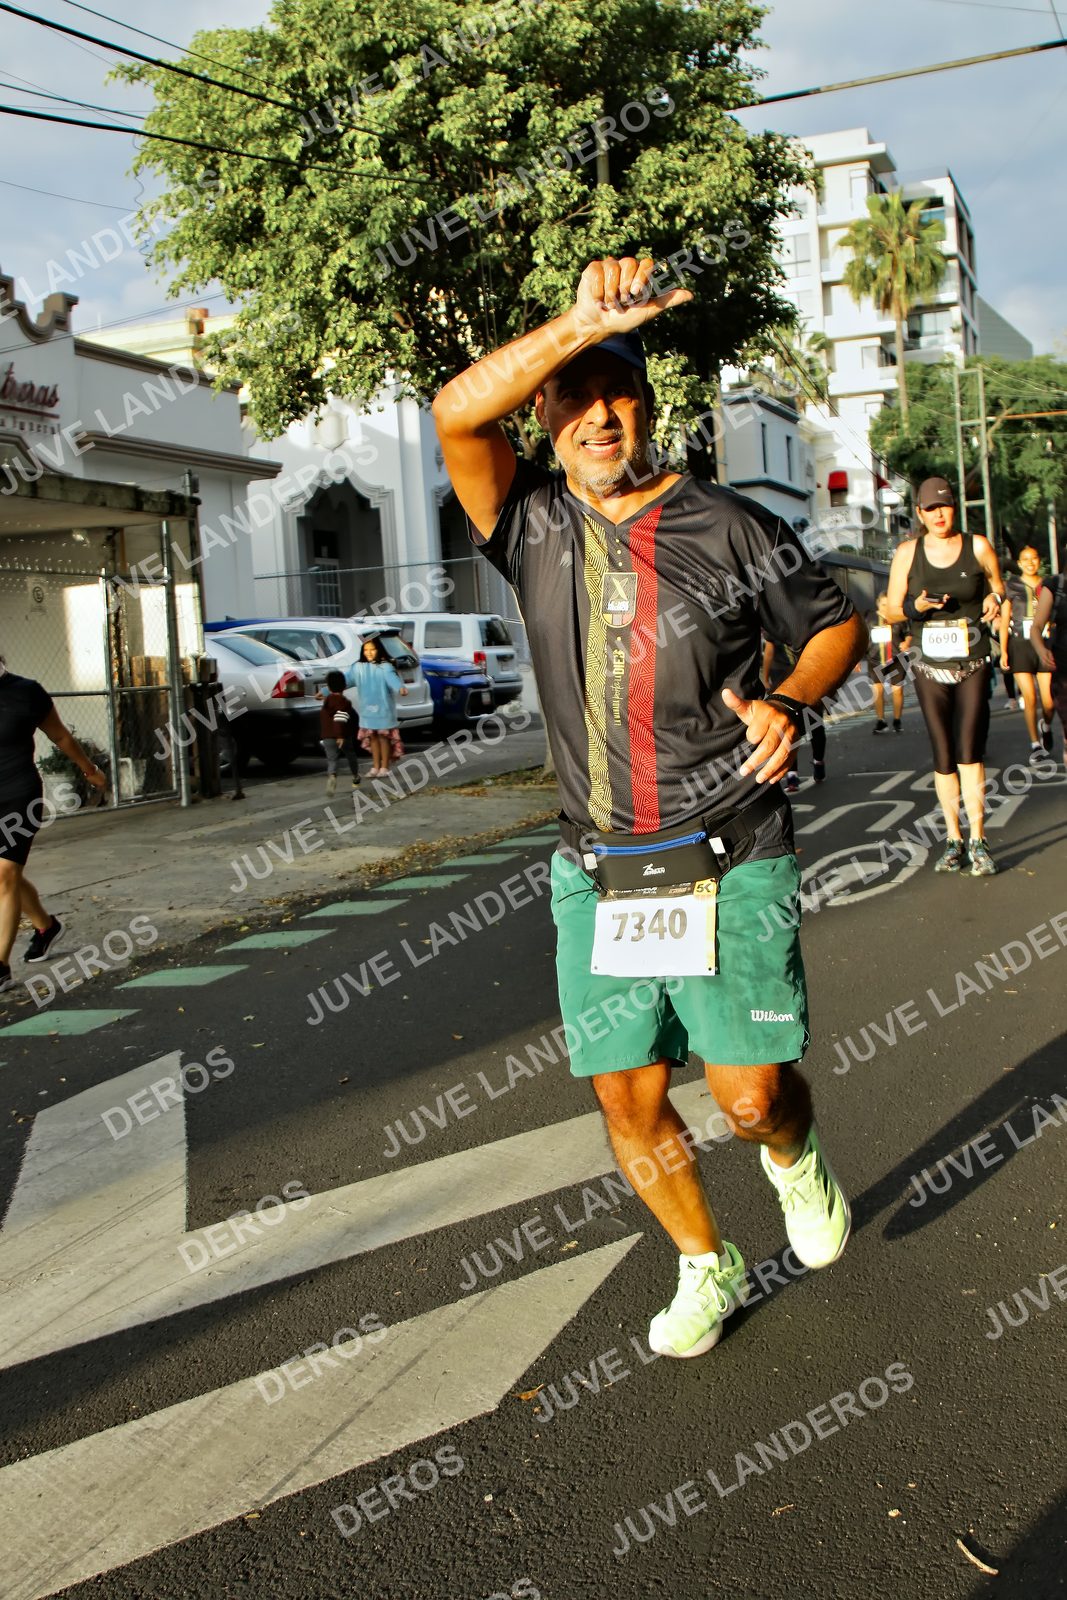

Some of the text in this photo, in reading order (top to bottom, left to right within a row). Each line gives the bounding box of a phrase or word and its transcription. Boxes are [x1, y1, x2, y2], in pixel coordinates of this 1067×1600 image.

[928, 632, 958, 644] 6690
[612, 908, 688, 942] 7340
[750, 1009, 795, 1022] Wilson
